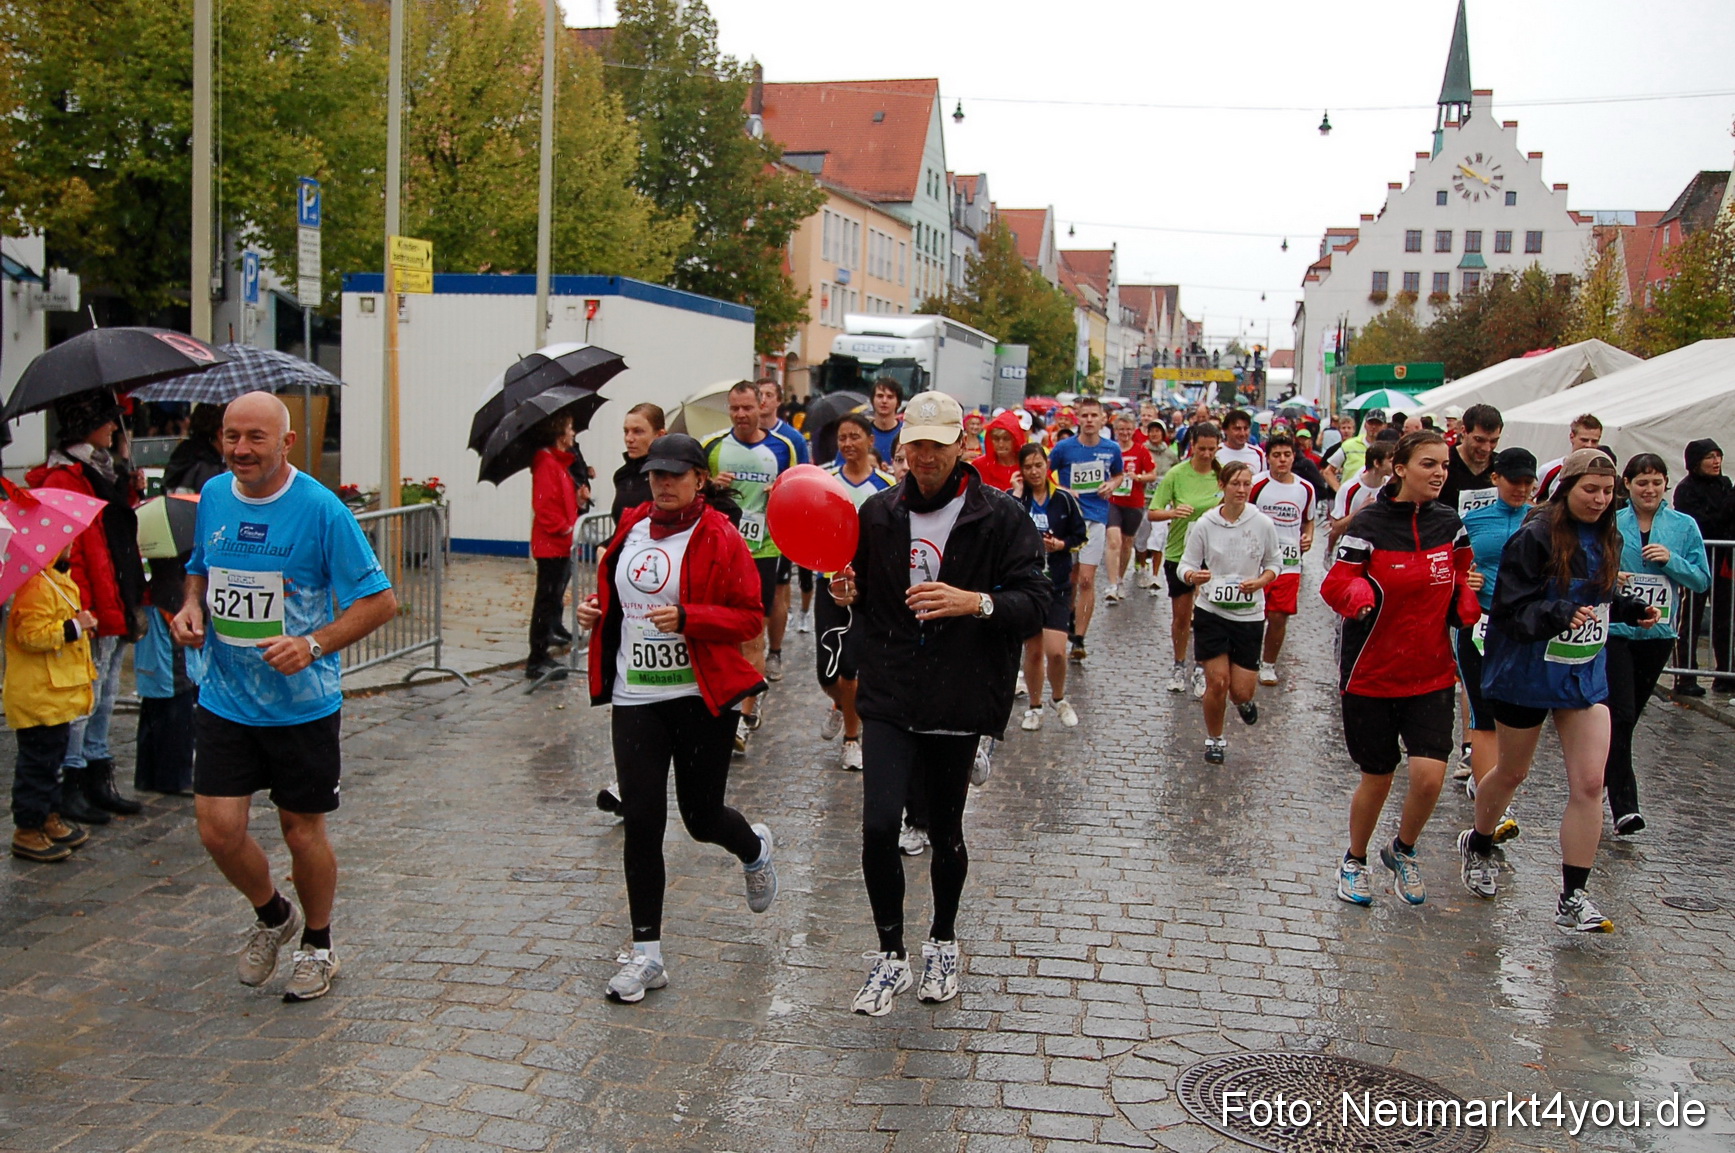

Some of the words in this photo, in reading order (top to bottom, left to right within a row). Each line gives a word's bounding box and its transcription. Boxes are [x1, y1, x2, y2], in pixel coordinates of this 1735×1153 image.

[246, 257, 257, 297] P
[728, 471, 770, 483] OCK
[1074, 470, 1101, 483] 5219
[740, 522, 759, 539] 49
[213, 588, 274, 619] 5217
[1621, 585, 1667, 605] 5214
[632, 642, 690, 669] 5038
[638, 672, 683, 683] Michaela
